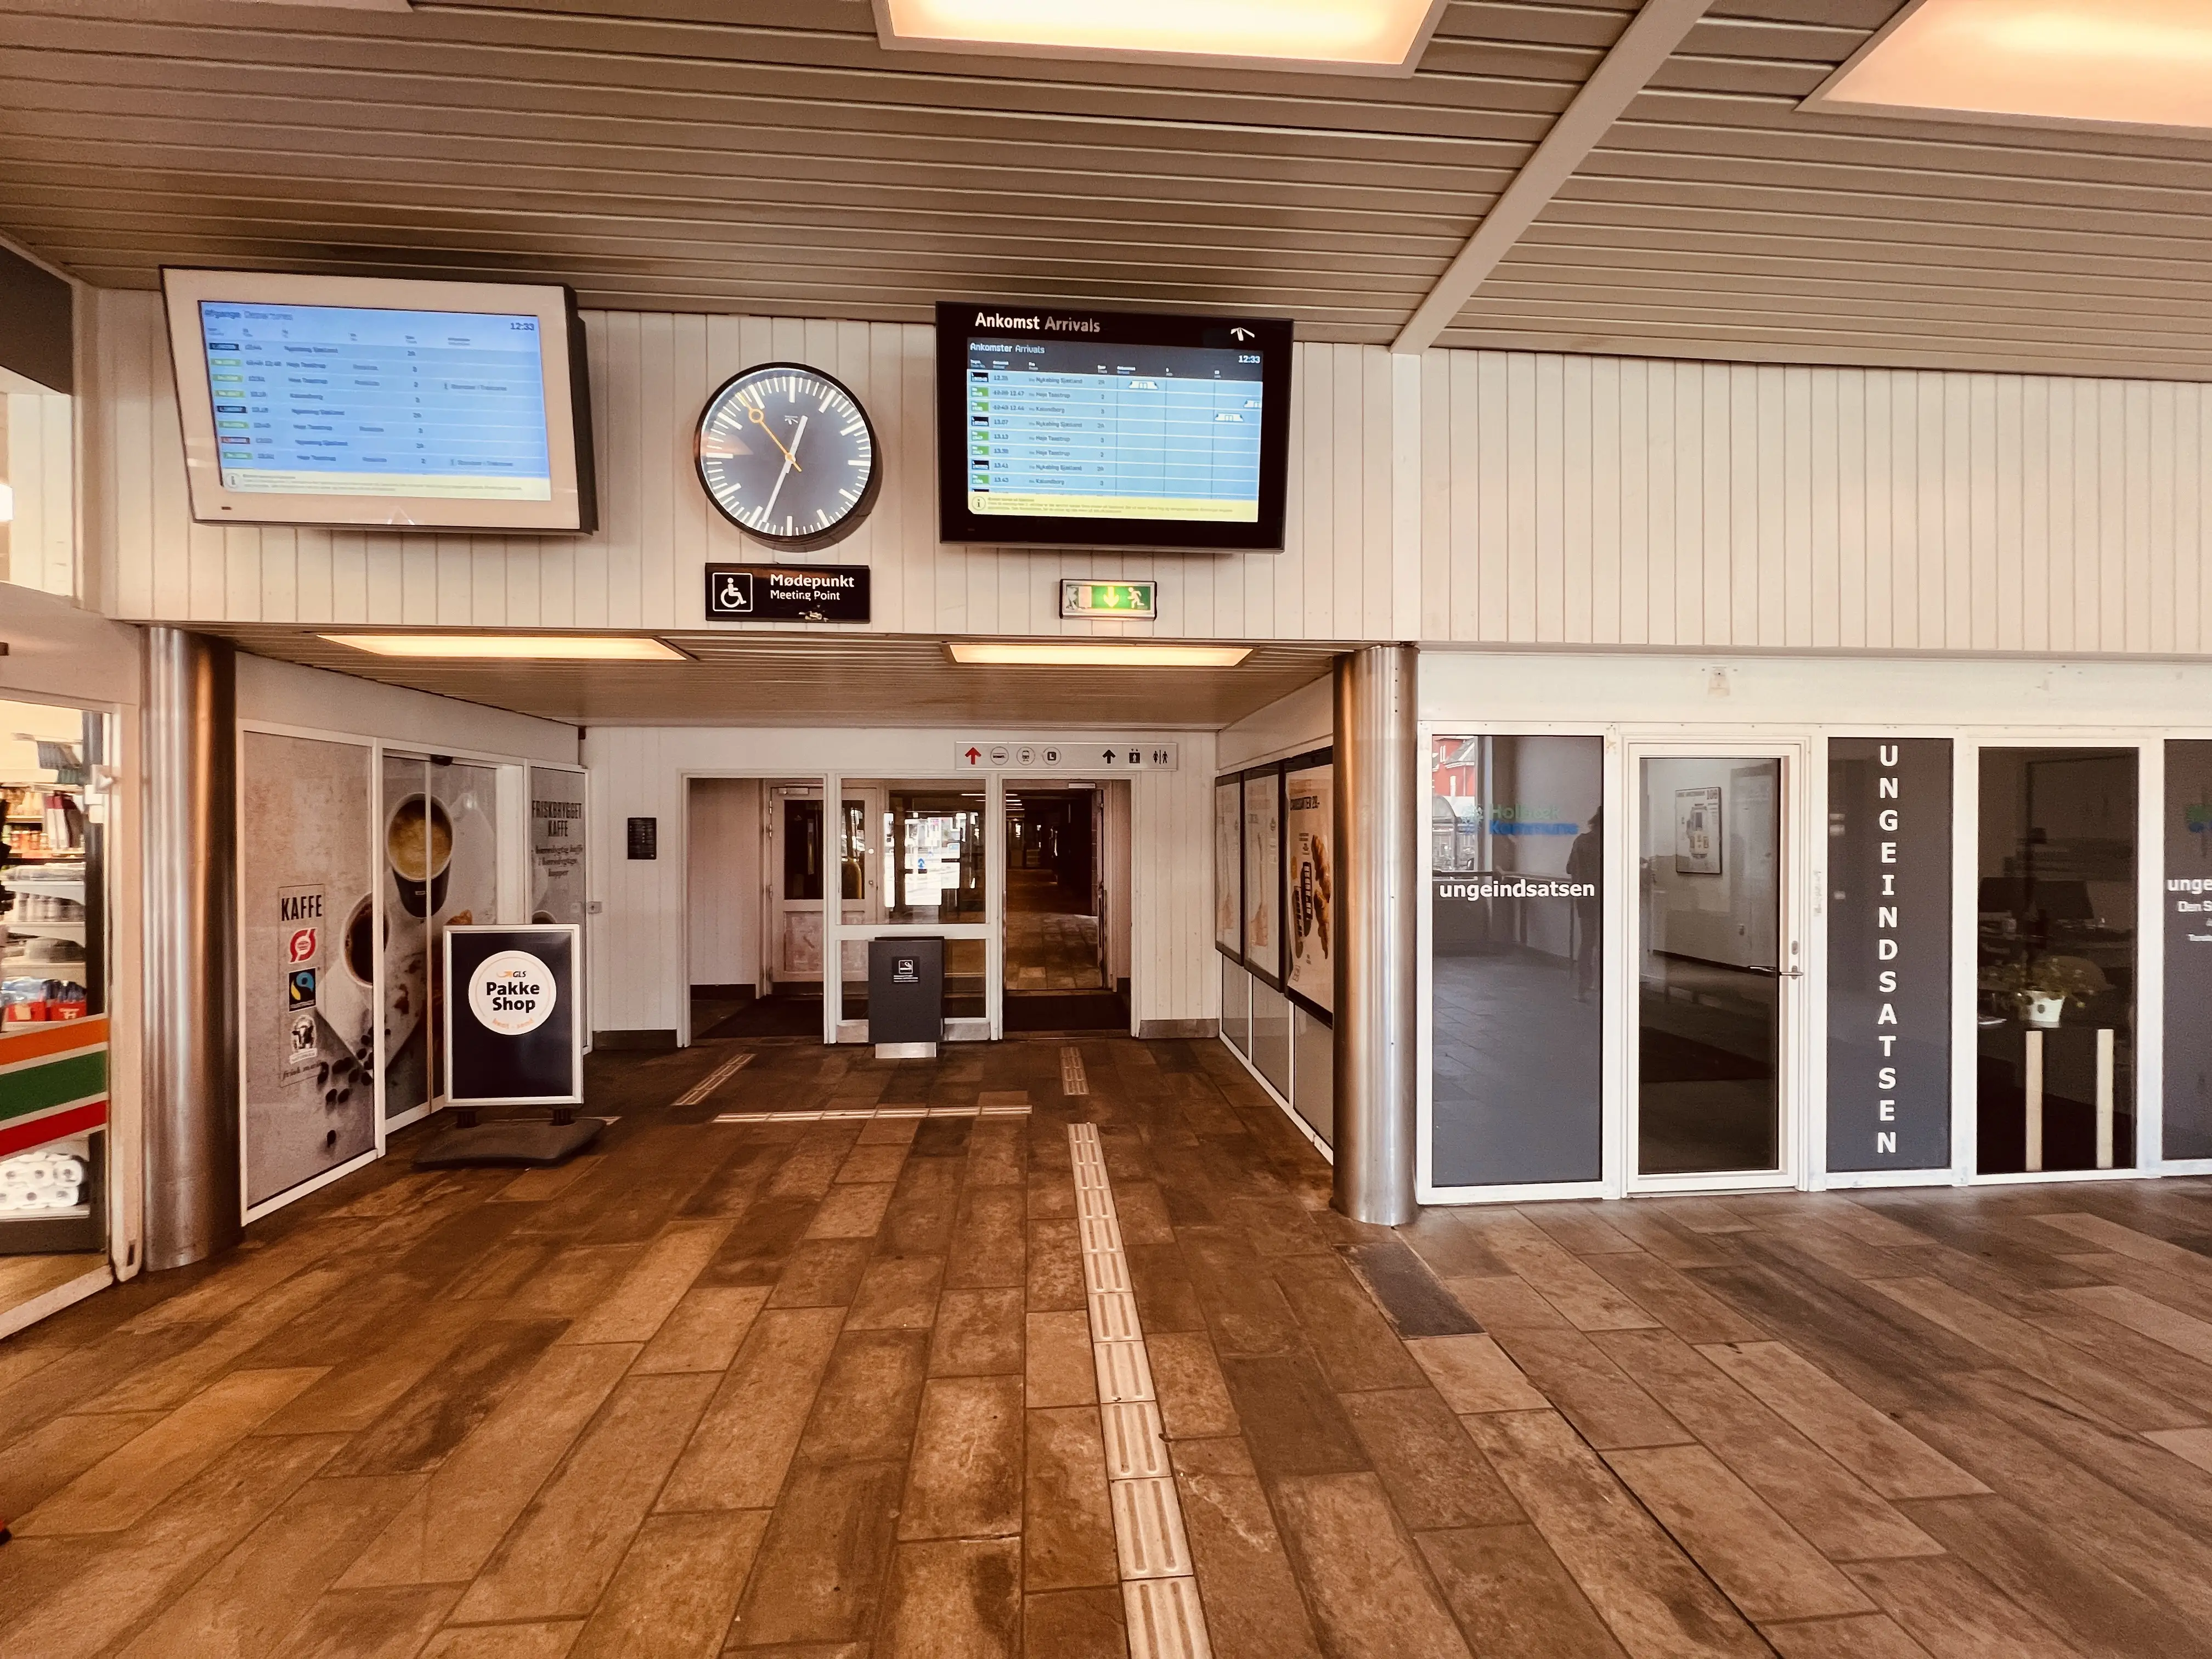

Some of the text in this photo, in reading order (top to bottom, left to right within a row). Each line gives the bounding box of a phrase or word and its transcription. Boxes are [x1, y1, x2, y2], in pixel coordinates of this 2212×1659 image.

[975, 312, 1101, 334] Ankomst Arrivals
[970, 343, 1046, 354] Ankomster Arrivals
[1238, 355, 1261, 364] 12:33
[770, 574, 855, 589] Mødepunkt
[770, 590, 840, 601] Meeting Point
[1440, 879, 1595, 901] ungeindsatsen
[281, 895, 323, 922] KAFFE
[1877, 744, 1899, 1154] UNGEINDSATSEN
[486, 981, 540, 996] Pakke
[492, 997, 536, 1013] Shop
